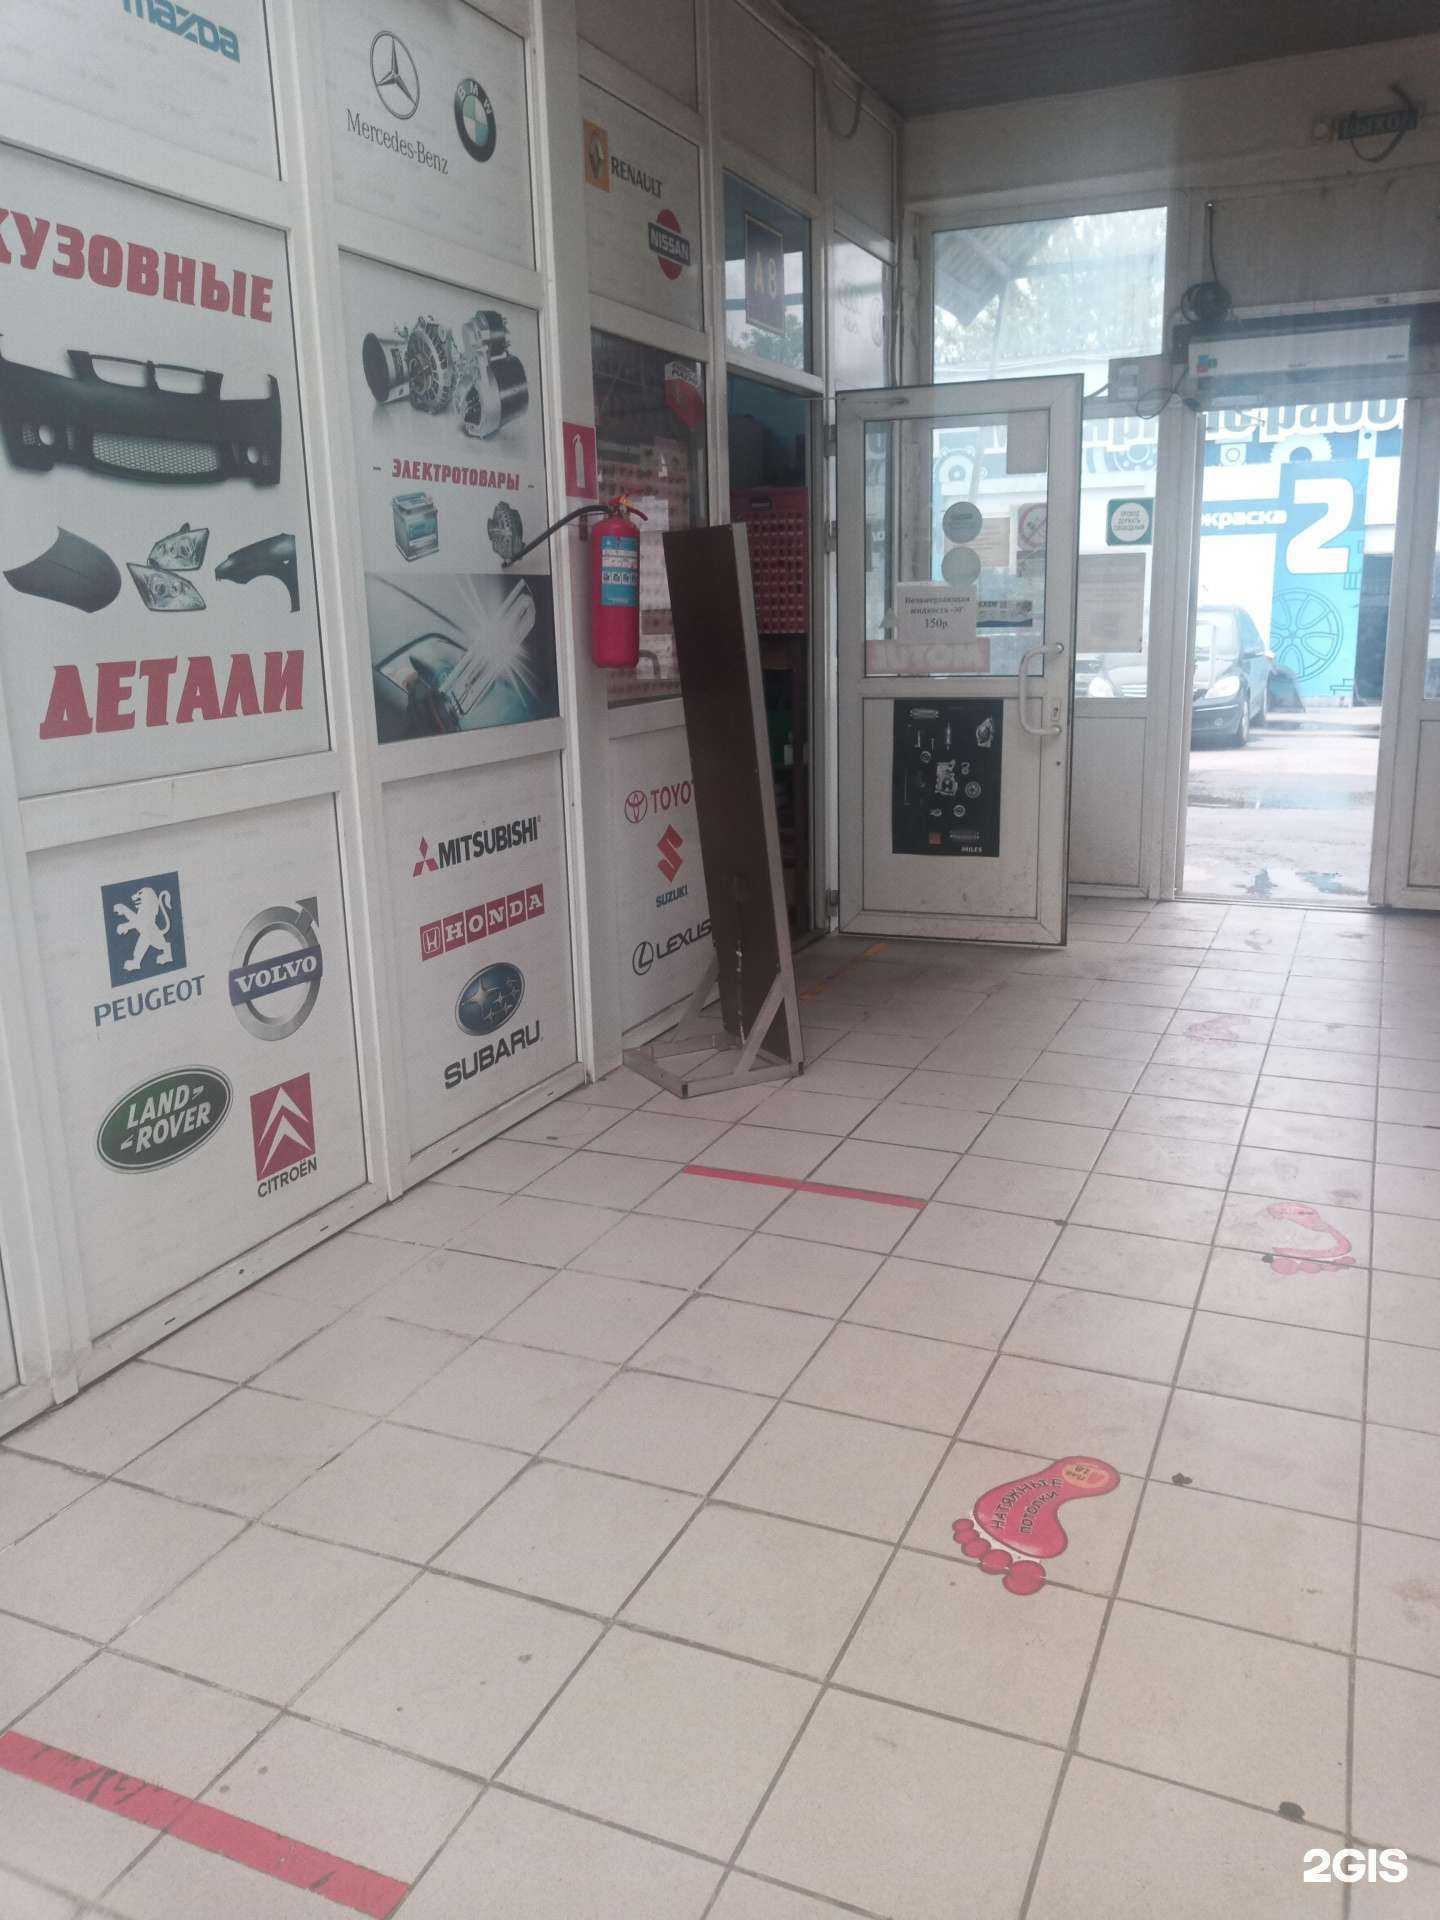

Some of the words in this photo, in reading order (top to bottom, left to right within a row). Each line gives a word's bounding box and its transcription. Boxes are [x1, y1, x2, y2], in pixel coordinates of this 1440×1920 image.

[346, 109, 449, 175] Mercedes-Benz
[611, 156, 663, 199] RENAULT
[650, 229, 690, 261] NISSAN
[391, 458, 520, 490] ЭЛЕКТРОТОВАРЫ
[1286, 478, 1354, 574] 2
[39, 649, 304, 740] ДЕТАЛИ
[650, 780, 695, 813] TOYO
[438, 816, 538, 869] MITSUBISHI
[445, 892, 543, 942] HONDA
[655, 884, 689, 908] SUZUKI
[656, 918, 713, 959] LEXUS
[234, 954, 318, 994] VOLVO
[94, 975, 205, 1027] PEUGEOT
[444, 1020, 541, 1090] SUBARU
[257, 1156, 318, 1198] CITROËN
[991, 1477, 1063, 1530] НАТЯЖНЫЕ
[1020, 1490, 1058, 1534] ПОТОЛКИ
